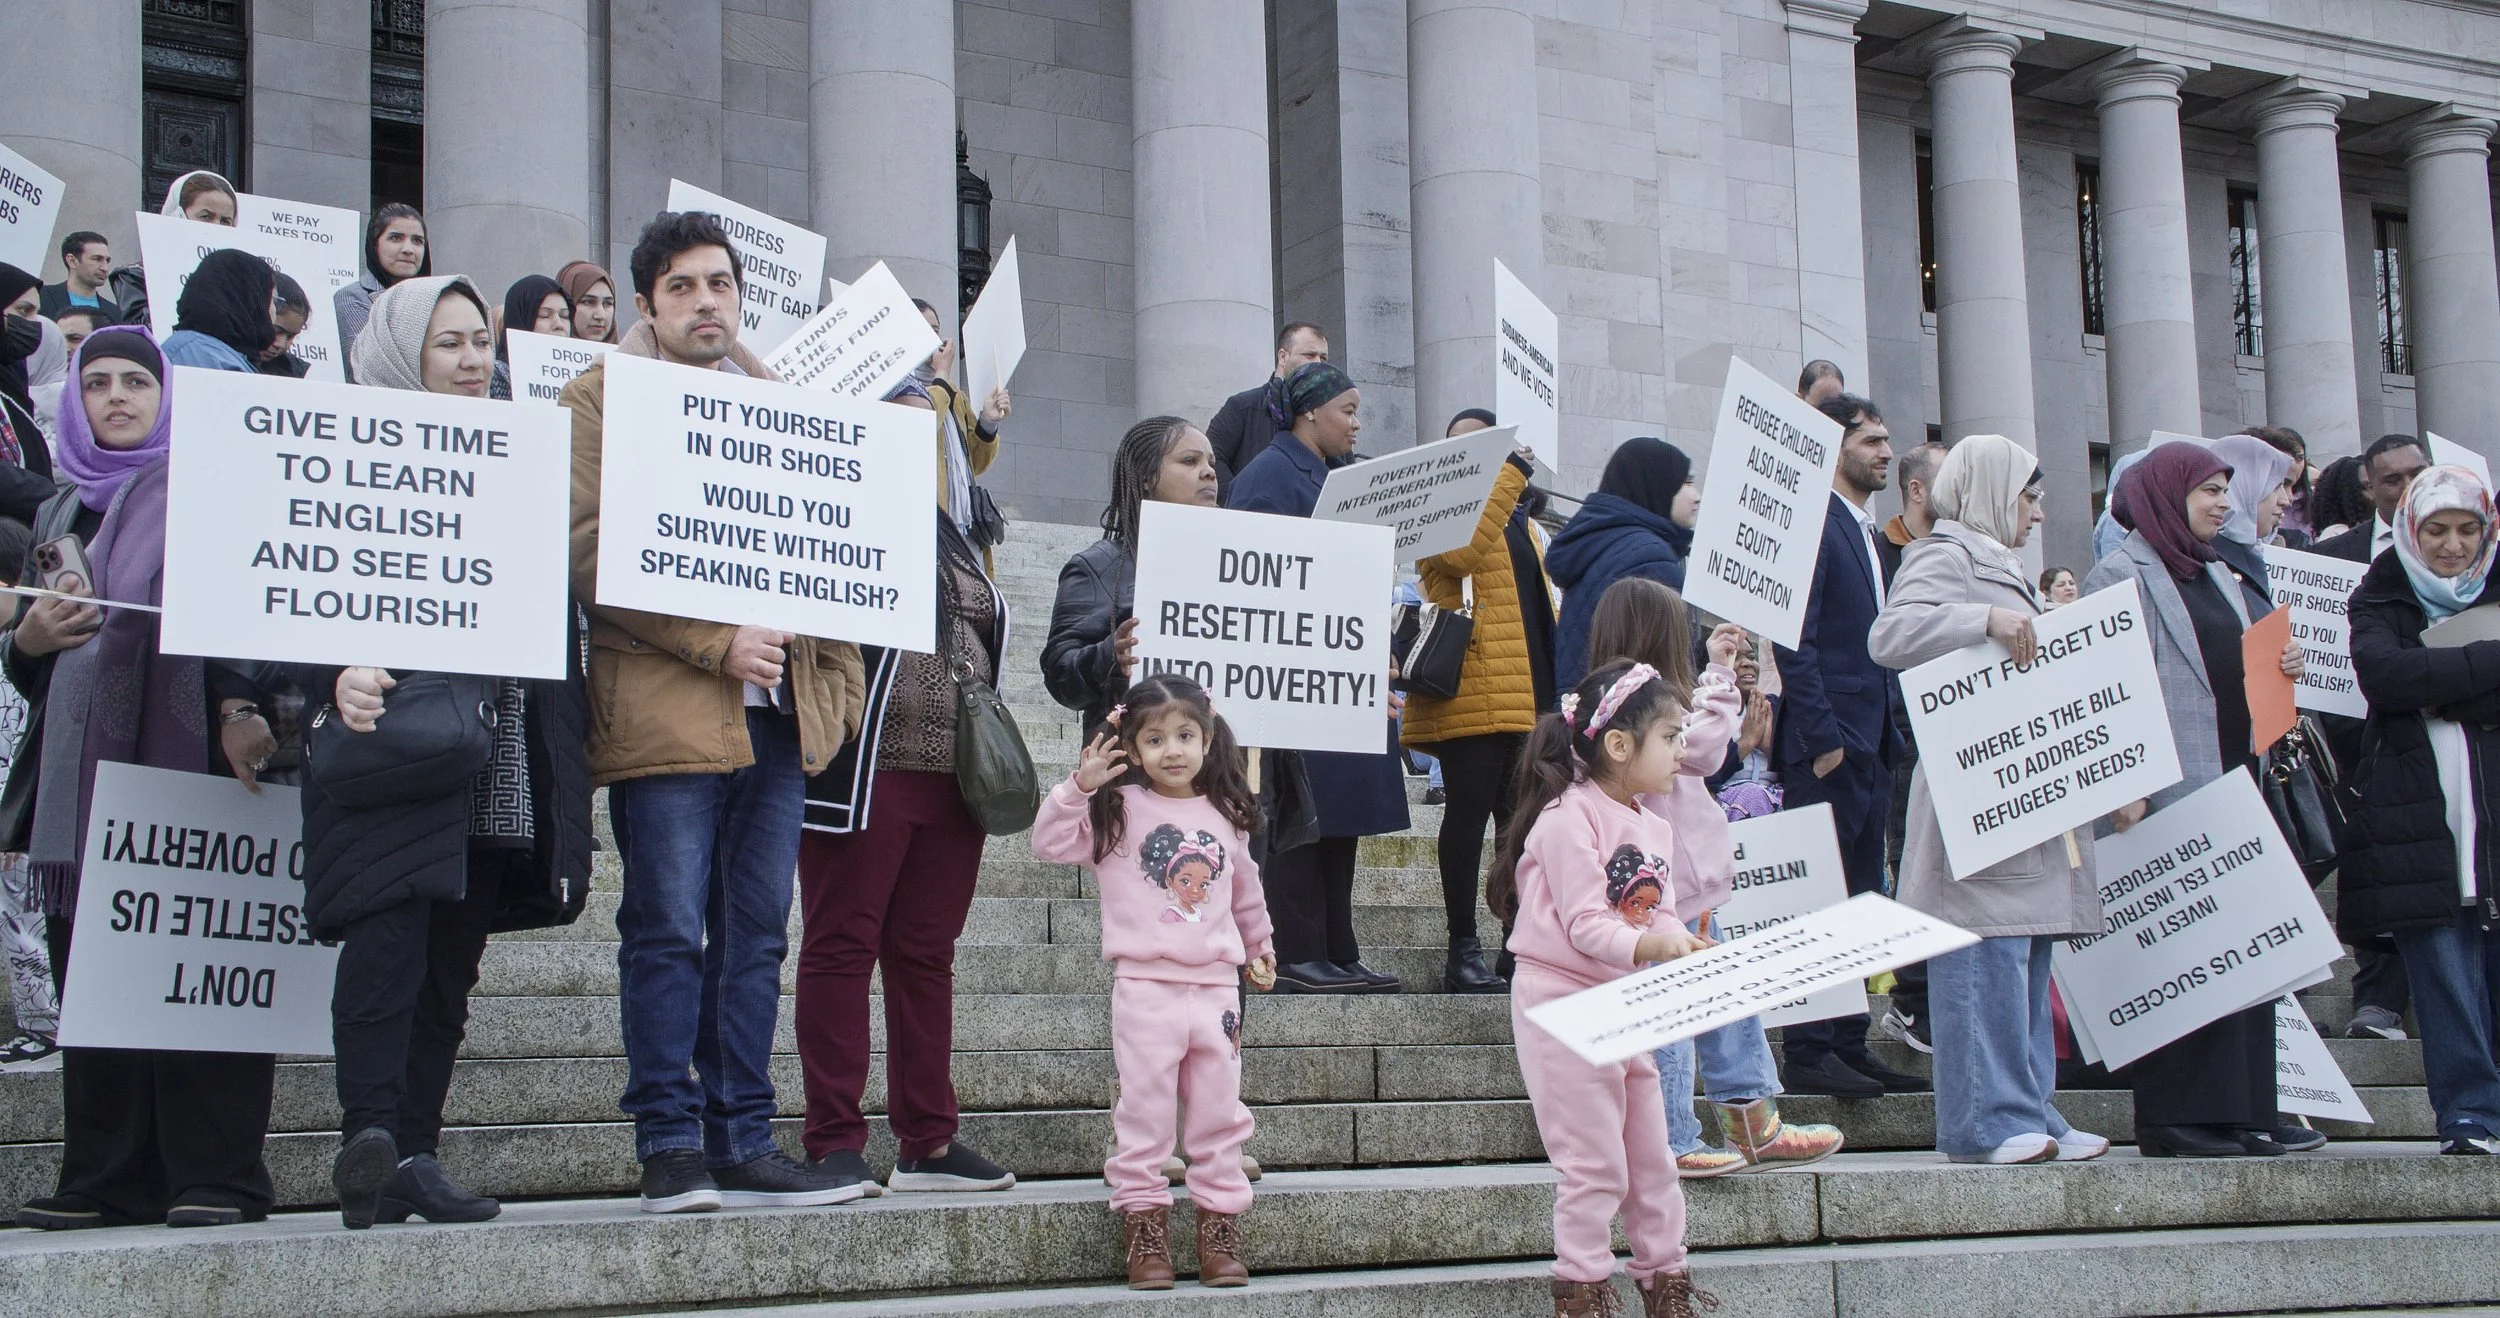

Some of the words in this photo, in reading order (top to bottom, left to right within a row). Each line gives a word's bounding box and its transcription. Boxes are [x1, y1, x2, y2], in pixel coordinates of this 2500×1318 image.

[0, 165, 42, 206] RIERS
[0, 199, 19, 224] BS
[272, 211, 292, 224] WE
[296, 216, 320, 228] PAY
[258, 224, 299, 239] TAXES
[301, 230, 333, 245] TOO!
[723, 216, 785, 254] DDRESS
[738, 250, 802, 288] UDENTS'
[781, 296, 812, 319] GAP
[290, 344, 327, 360] LISH
[794, 344, 843, 387] TRUST
[848, 306, 890, 344] FUND
[795, 307, 848, 354] FUNDS
[1501, 318, 1554, 379] SUDANESE-AMERICAN
[542, 365, 571, 379] FOR
[552, 348, 593, 365] DROP
[800, 340, 831, 368] THE
[831, 350, 881, 394] USING
[850, 347, 906, 396] MILIES
[528, 382, 560, 400] MOR
[1502, 347, 1518, 377] AND
[1519, 361, 1532, 390] WE
[1532, 374, 1554, 410] VOTE!
[244, 405, 337, 441] GIVE
[351, 416, 404, 447] US
[416, 423, 509, 458] TIME
[683, 394, 732, 423] PUT
[739, 403, 867, 447] YOURSELF
[1735, 395, 1779, 441] REFUGEE
[1780, 422, 1826, 469] CHILDREN
[276, 453, 332, 484] TO
[345, 459, 475, 498] LEARN
[686, 431, 712, 457] IN
[721, 437, 772, 468] OUR
[781, 448, 863, 483] SHOES
[1369, 460, 1435, 488] POVERTY
[1436, 450, 1467, 469] HAS
[1747, 445, 1774, 479] ALSO
[1774, 459, 1801, 495] HAVE
[703, 482, 794, 519] WOULD
[802, 499, 851, 529] YOU
[1335, 463, 1482, 514] INTERGENERATIONAL
[1376, 493, 1432, 518] IMPACT
[1738, 483, 1749, 506] A
[1749, 488, 1779, 525] RIGHT
[1778, 502, 1793, 530] TO
[289, 498, 462, 540] ENGLISH
[1397, 518, 1414, 533] TO
[1417, 499, 1482, 527] SUPPORT
[657, 513, 767, 553] SURVIVE
[773, 532, 887, 572] WITHOUT
[1394, 532, 1423, 550] IDS!
[1736, 522, 1782, 564] EQUITY
[251, 540, 339, 573] AND
[352, 548, 429, 581] SEE
[442, 556, 493, 586] US
[640, 549, 770, 592] SPEAKING
[779, 571, 899, 612] ENGLISH?
[1219, 548, 1313, 590] DON'T
[1707, 549, 1722, 575] IN
[1722, 558, 1792, 611] EDUCATION
[2265, 563, 2288, 581] PUT
[2291, 568, 2354, 594] YOURSELF
[265, 586, 478, 629] FLOURISH!
[2277, 589, 2303, 608] OUR
[2306, 595, 2348, 616] SHOES
[1160, 600, 1314, 647] RESETTLE
[1324, 615, 1364, 651] US
[2312, 626, 2337, 644] YOU
[1919, 666, 1995, 715] DON'T
[2100, 610, 2134, 639] US
[1224, 663, 1376, 708] POVERTY!
[1956, 725, 2025, 771] WHERE
[2027, 717, 2047, 740] IS
[2049, 700, 2086, 730] THE
[2088, 682, 2131, 714] BILL
[1993, 763, 2019, 790] TO
[2025, 724, 2110, 778] ADDRESS
[1971, 776, 2070, 835] REFUGEES'
[2076, 743, 2146, 789] NEEDS?
[102, 818, 278, 878] POVERTY!
[2175, 833, 2213, 863] FOR
[2211, 837, 2264, 879] ADULT
[2174, 867, 2209, 894] ESL
[110, 889, 160, 933] US
[170, 894, 338, 948] ESETTLE
[2159, 895, 2218, 939] INVEST
[1746, 937, 1819, 964] NEED
[1752, 928, 1805, 950] AND
[1783, 925, 1930, 976] PAYCHECK
[2136, 928, 2157, 950] IN
[2246, 917, 2304, 959] HELP
[1621, 951, 1748, 994] TRAINING
[1751, 951, 1893, 1001] ENGINEER
[2210, 950, 2242, 975] US
[164, 962, 276, 1009] DON'T
[1625, 963, 1740, 1006] ENGLISH
[1740, 977, 1778, 992] TO
[2109, 966, 2208, 1027] SUCCEED
[1586, 991, 1733, 1045] PAYCHECK
[1653, 999, 1746, 1034] LIVING
[2285, 1017, 2308, 1032] TOO
[2288, 1062, 2305, 1076] TO
[2277, 1084, 2342, 1104] MELESSNESS
